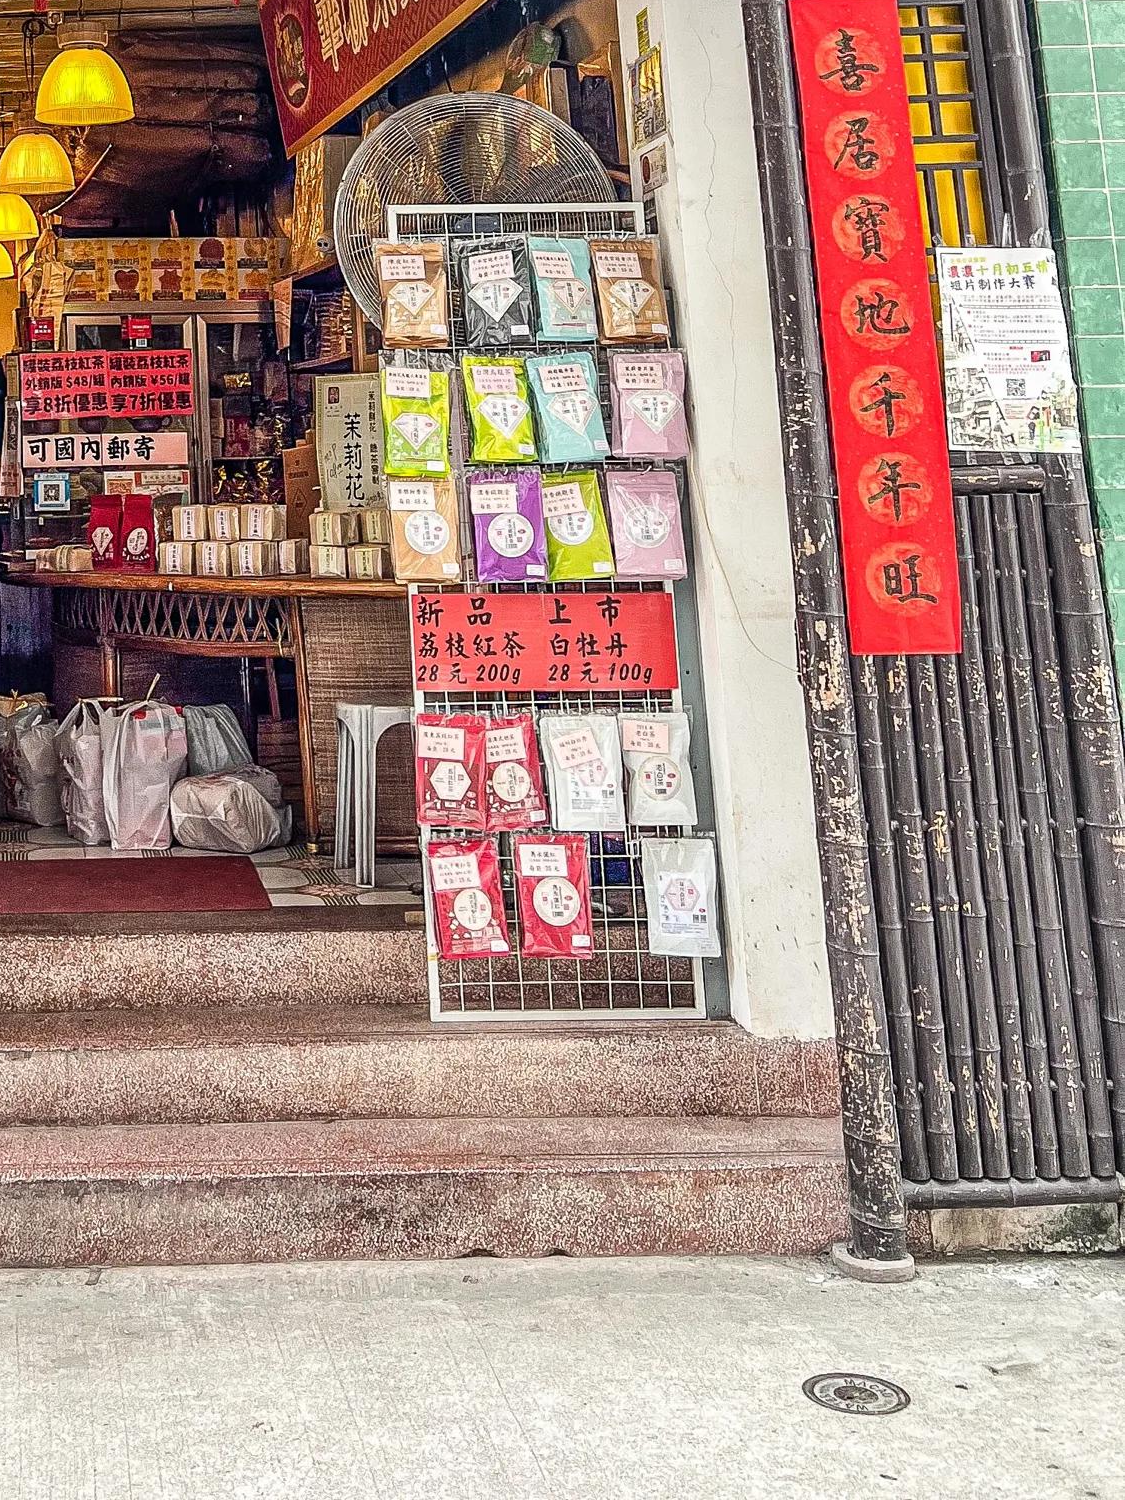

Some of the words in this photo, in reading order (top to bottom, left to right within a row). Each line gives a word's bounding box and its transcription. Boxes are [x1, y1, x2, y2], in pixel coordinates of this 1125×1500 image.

[818, 28, 939, 607] 喜居寶地千年旺
[25, 392, 108, 415] 享8折優惠
[111, 391, 192, 413] 享7折優惠
[27, 436, 155, 462] 可國內郵寄
[344, 412, 365, 507] 茉莉花
[416, 596, 492, 627] 新品
[548, 595, 622, 627] 上市
[418, 632, 526, 659] 荔枝紅茶
[549, 632, 628, 658] 白牡丹
[417, 664, 439, 682] 28
[448, 663, 467, 684] 元
[476, 664, 521, 684] 200g
[548, 664, 569, 682] 28
[580, 662, 599, 684] 元
[608, 664, 653, 684] 100g
